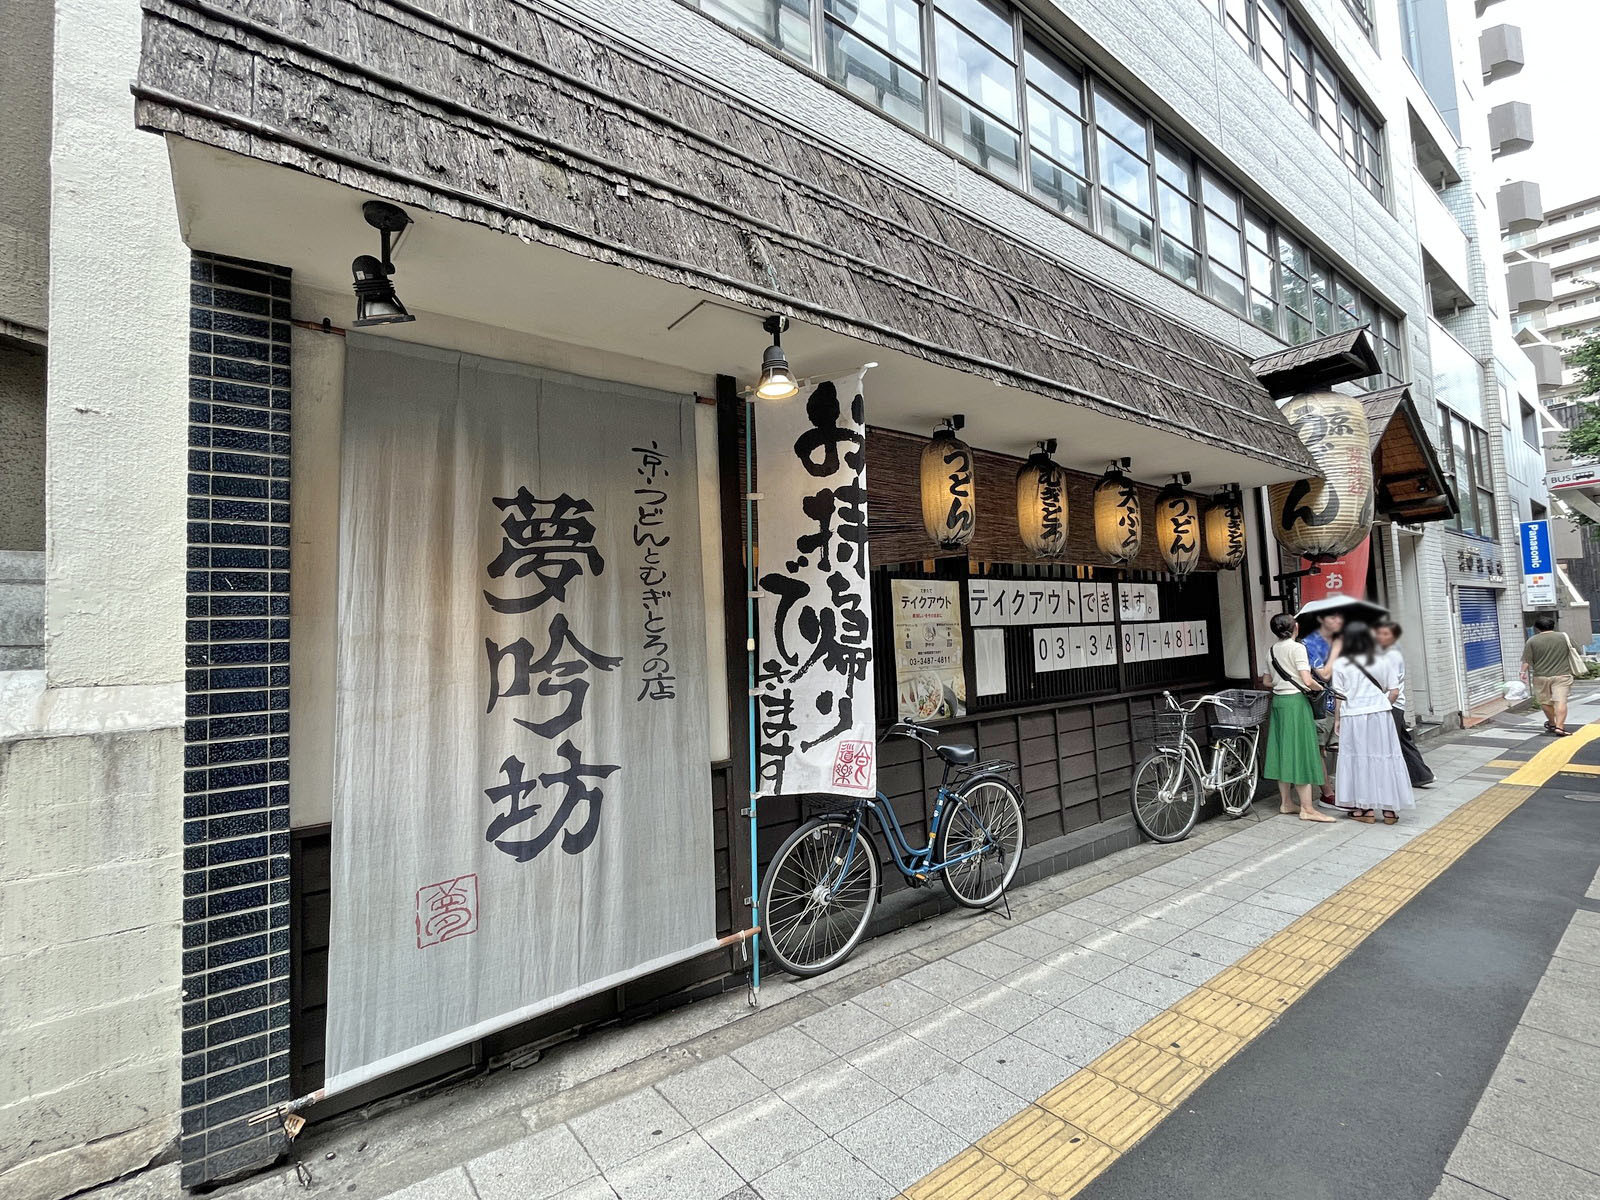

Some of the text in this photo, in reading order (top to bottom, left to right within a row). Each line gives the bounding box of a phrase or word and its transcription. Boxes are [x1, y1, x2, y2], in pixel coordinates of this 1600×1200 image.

[1326, 406, 1354, 436] 京
[1551, 474, 1571, 484] BUS
[793, 380, 872, 754] お持ち帰り
[1528, 524, 1543, 569] Panasonic
[632, 440, 676, 702] 京うどんとむぎとろの店
[901, 595, 952, 610] テイクアウト
[482, 485, 625, 864] 夢吟坊
[757, 556, 811, 796] できます
[909, 656, 951, 666] 03-3487-4811
